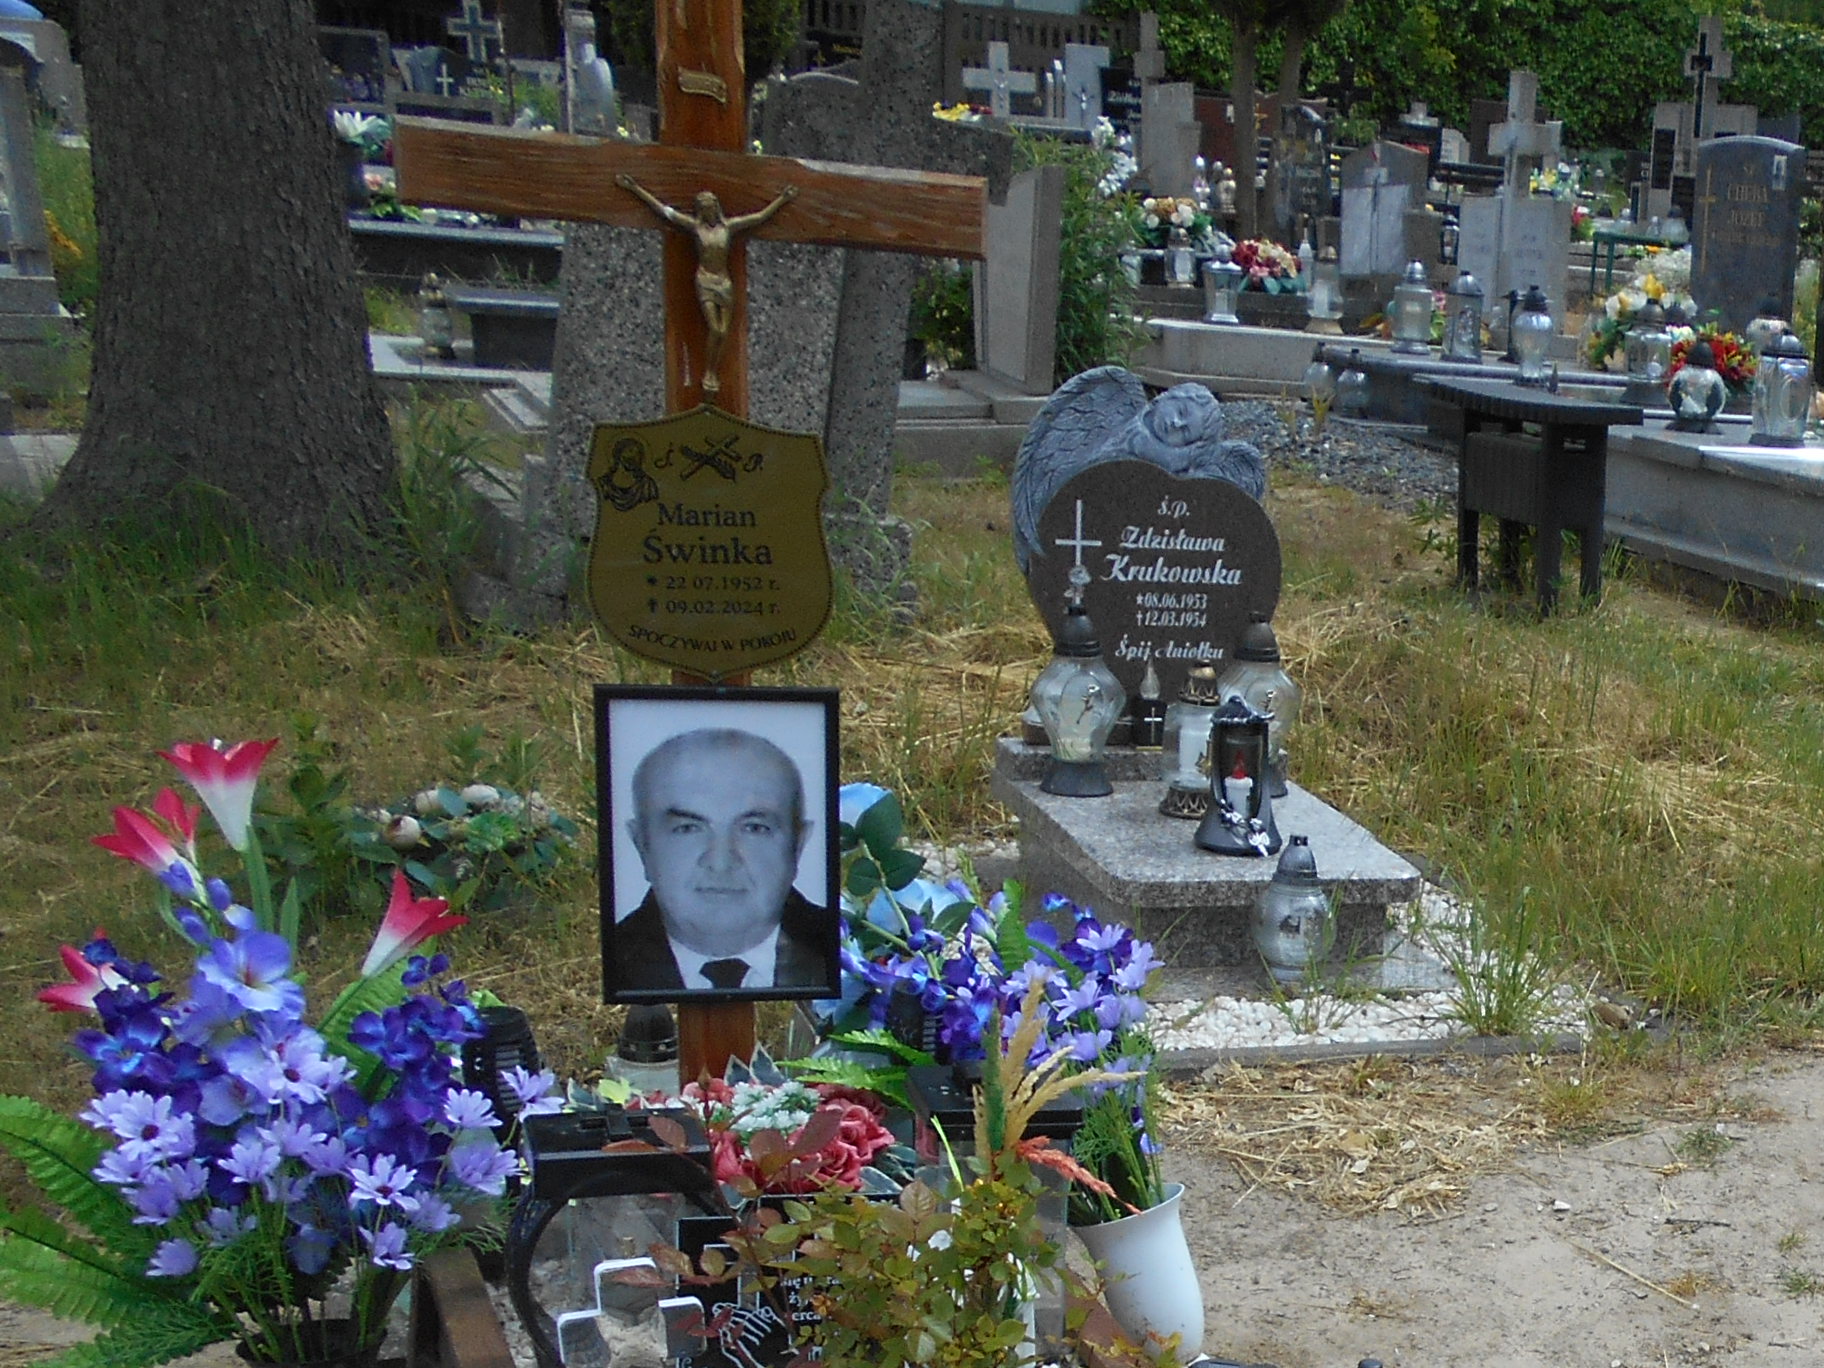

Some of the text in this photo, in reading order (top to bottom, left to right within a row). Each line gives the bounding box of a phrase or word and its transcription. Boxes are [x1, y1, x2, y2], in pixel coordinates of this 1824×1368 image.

[657, 503, 758, 527] Marian
[642, 529, 774, 565] Świnka
[1119, 525, 1227, 552] Zdzisława
[1100, 552, 1244, 586] Krukowska
[720, 639, 736, 651] W
[1154, 640, 1224, 660] Aniołku
